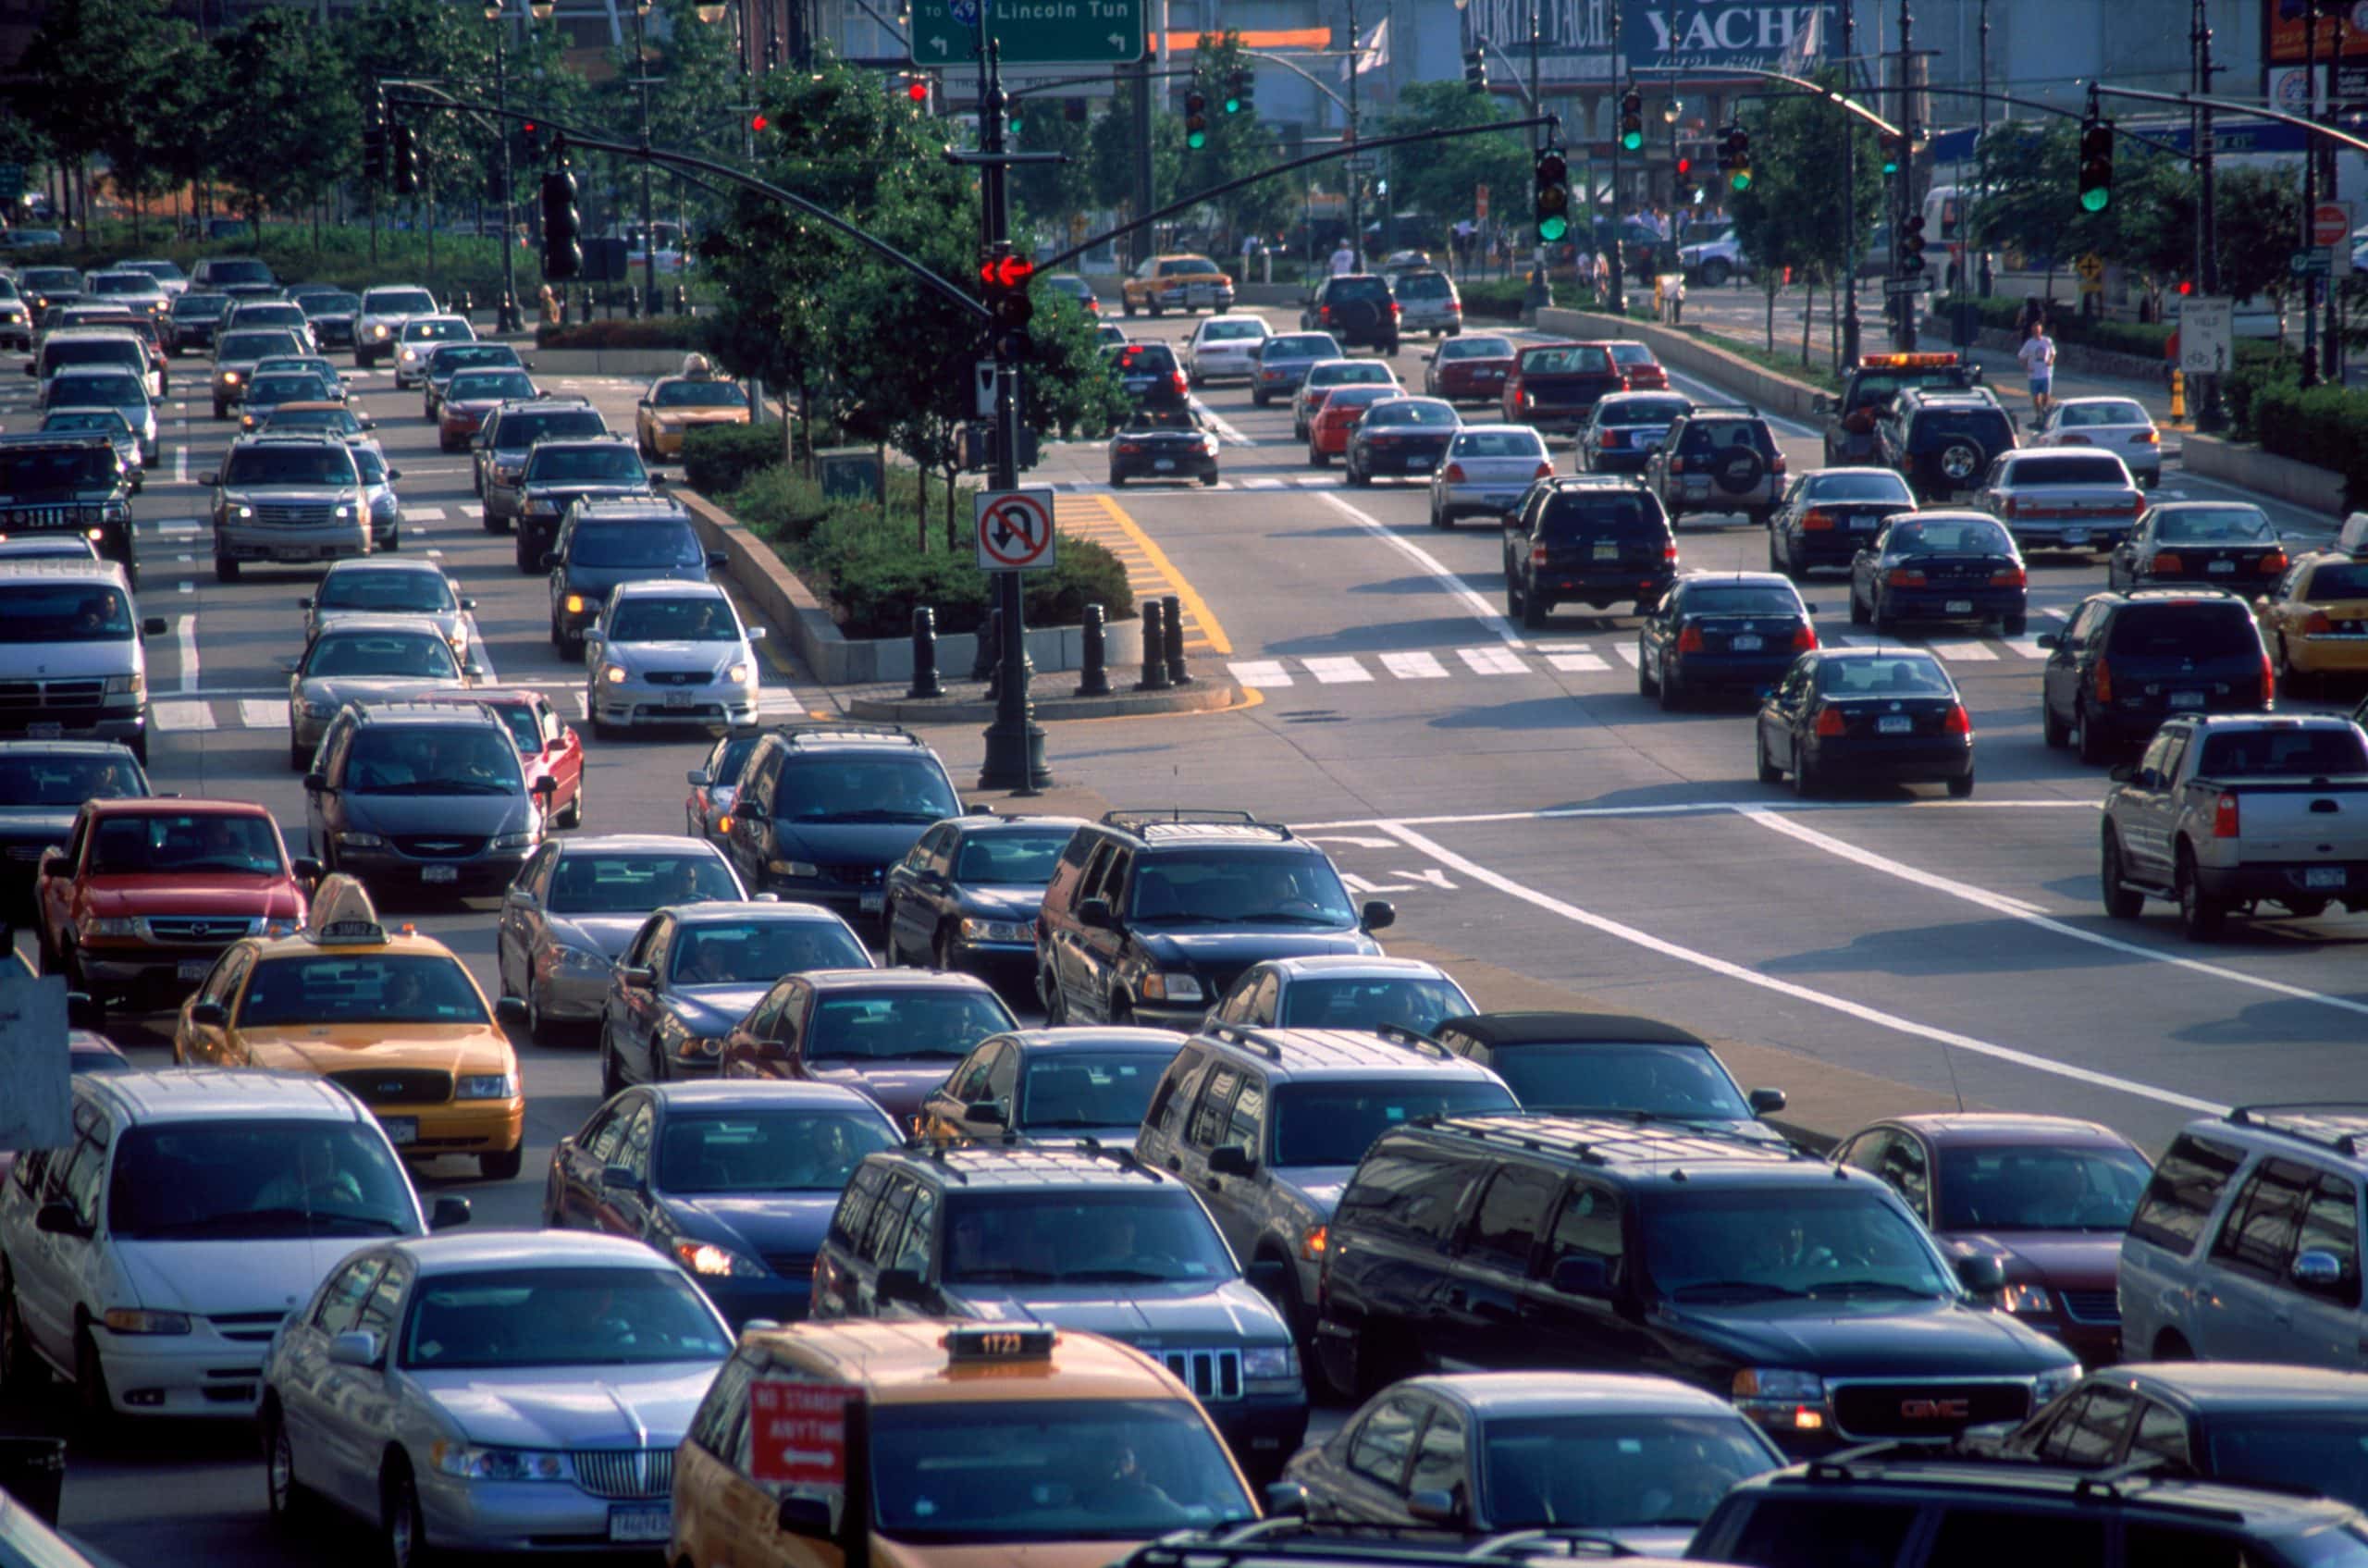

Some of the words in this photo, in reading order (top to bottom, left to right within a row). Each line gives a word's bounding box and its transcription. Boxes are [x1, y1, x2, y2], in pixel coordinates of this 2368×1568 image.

[925, 6, 942, 18] TO
[996, 2, 1077, 19] Lincoln
[1088, 1, 1128, 18] Tun
[757, 1389, 778, 1408] NO
[1901, 1397, 1969, 1417] GMC
